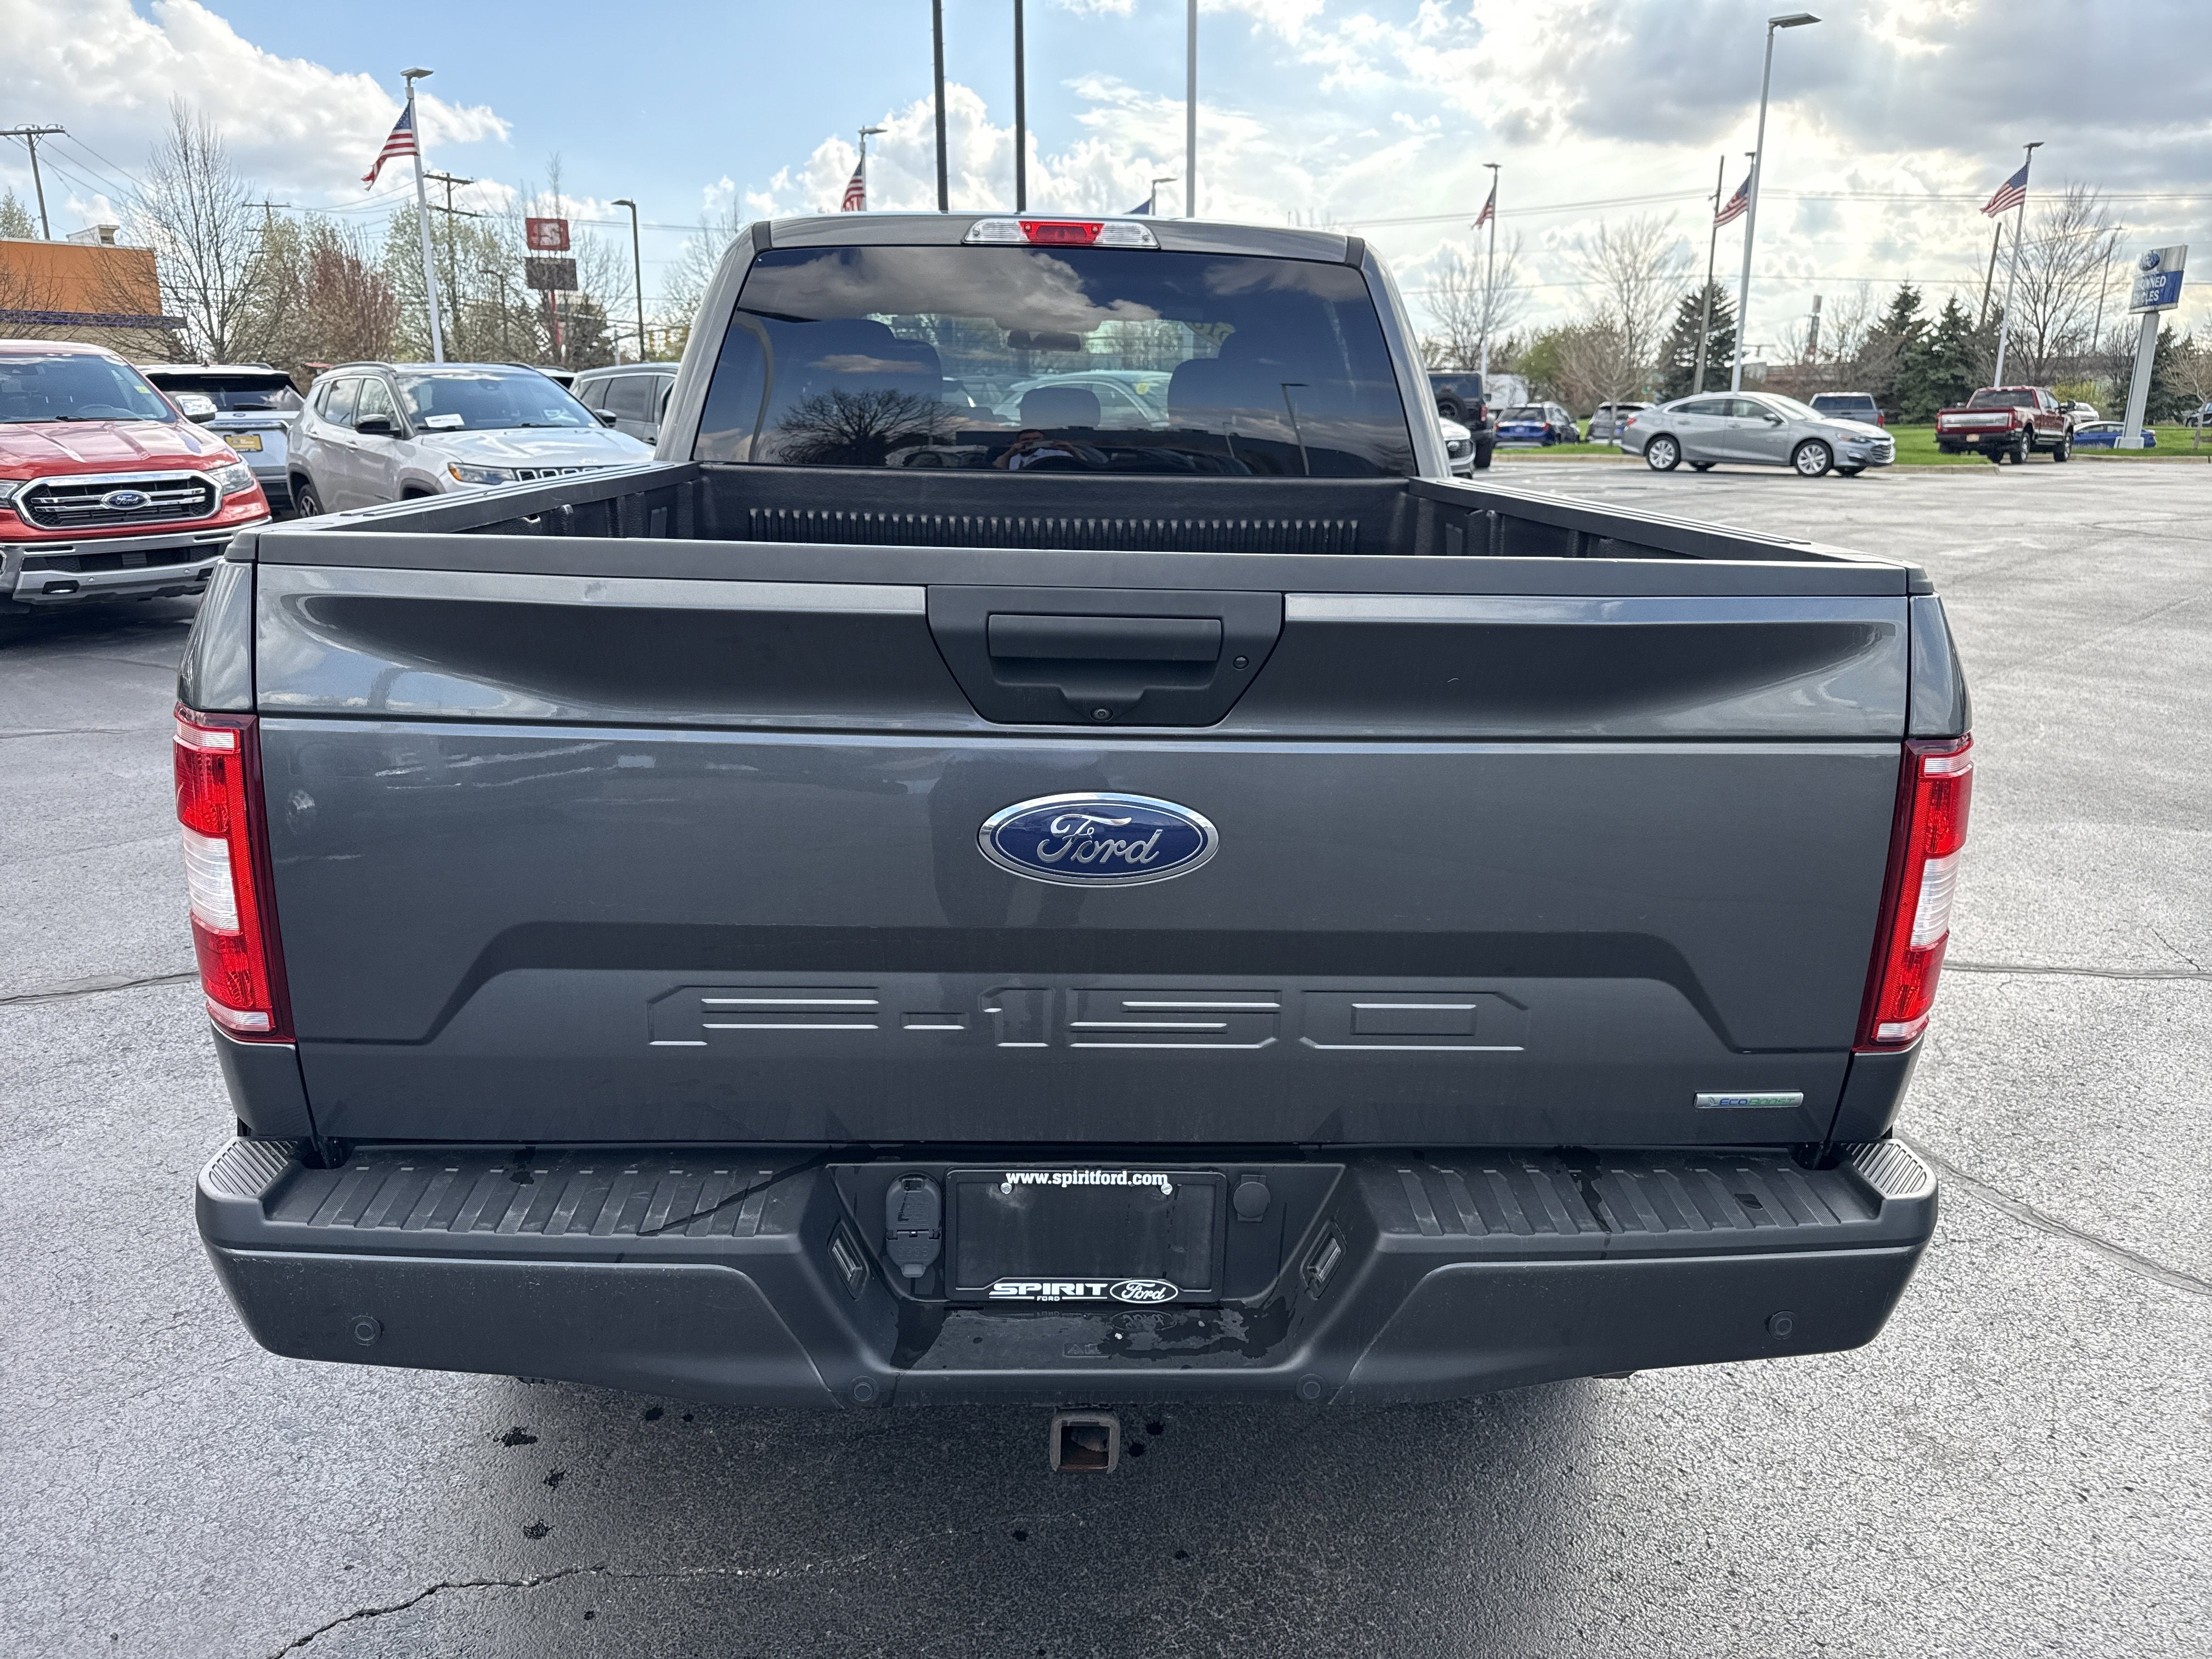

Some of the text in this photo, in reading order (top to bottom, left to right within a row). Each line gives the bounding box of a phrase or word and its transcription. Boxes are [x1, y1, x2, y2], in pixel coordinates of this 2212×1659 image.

[115, 494, 139, 505] Ford
[1036, 814, 1163, 864] Ford
[647, 984, 1532, 1051] F-150
[1006, 1170, 1168, 1187] www.spiritford.com
[989, 1283, 1108, 1295] SPIRIT
[1121, 1282, 1166, 1300] Ford
